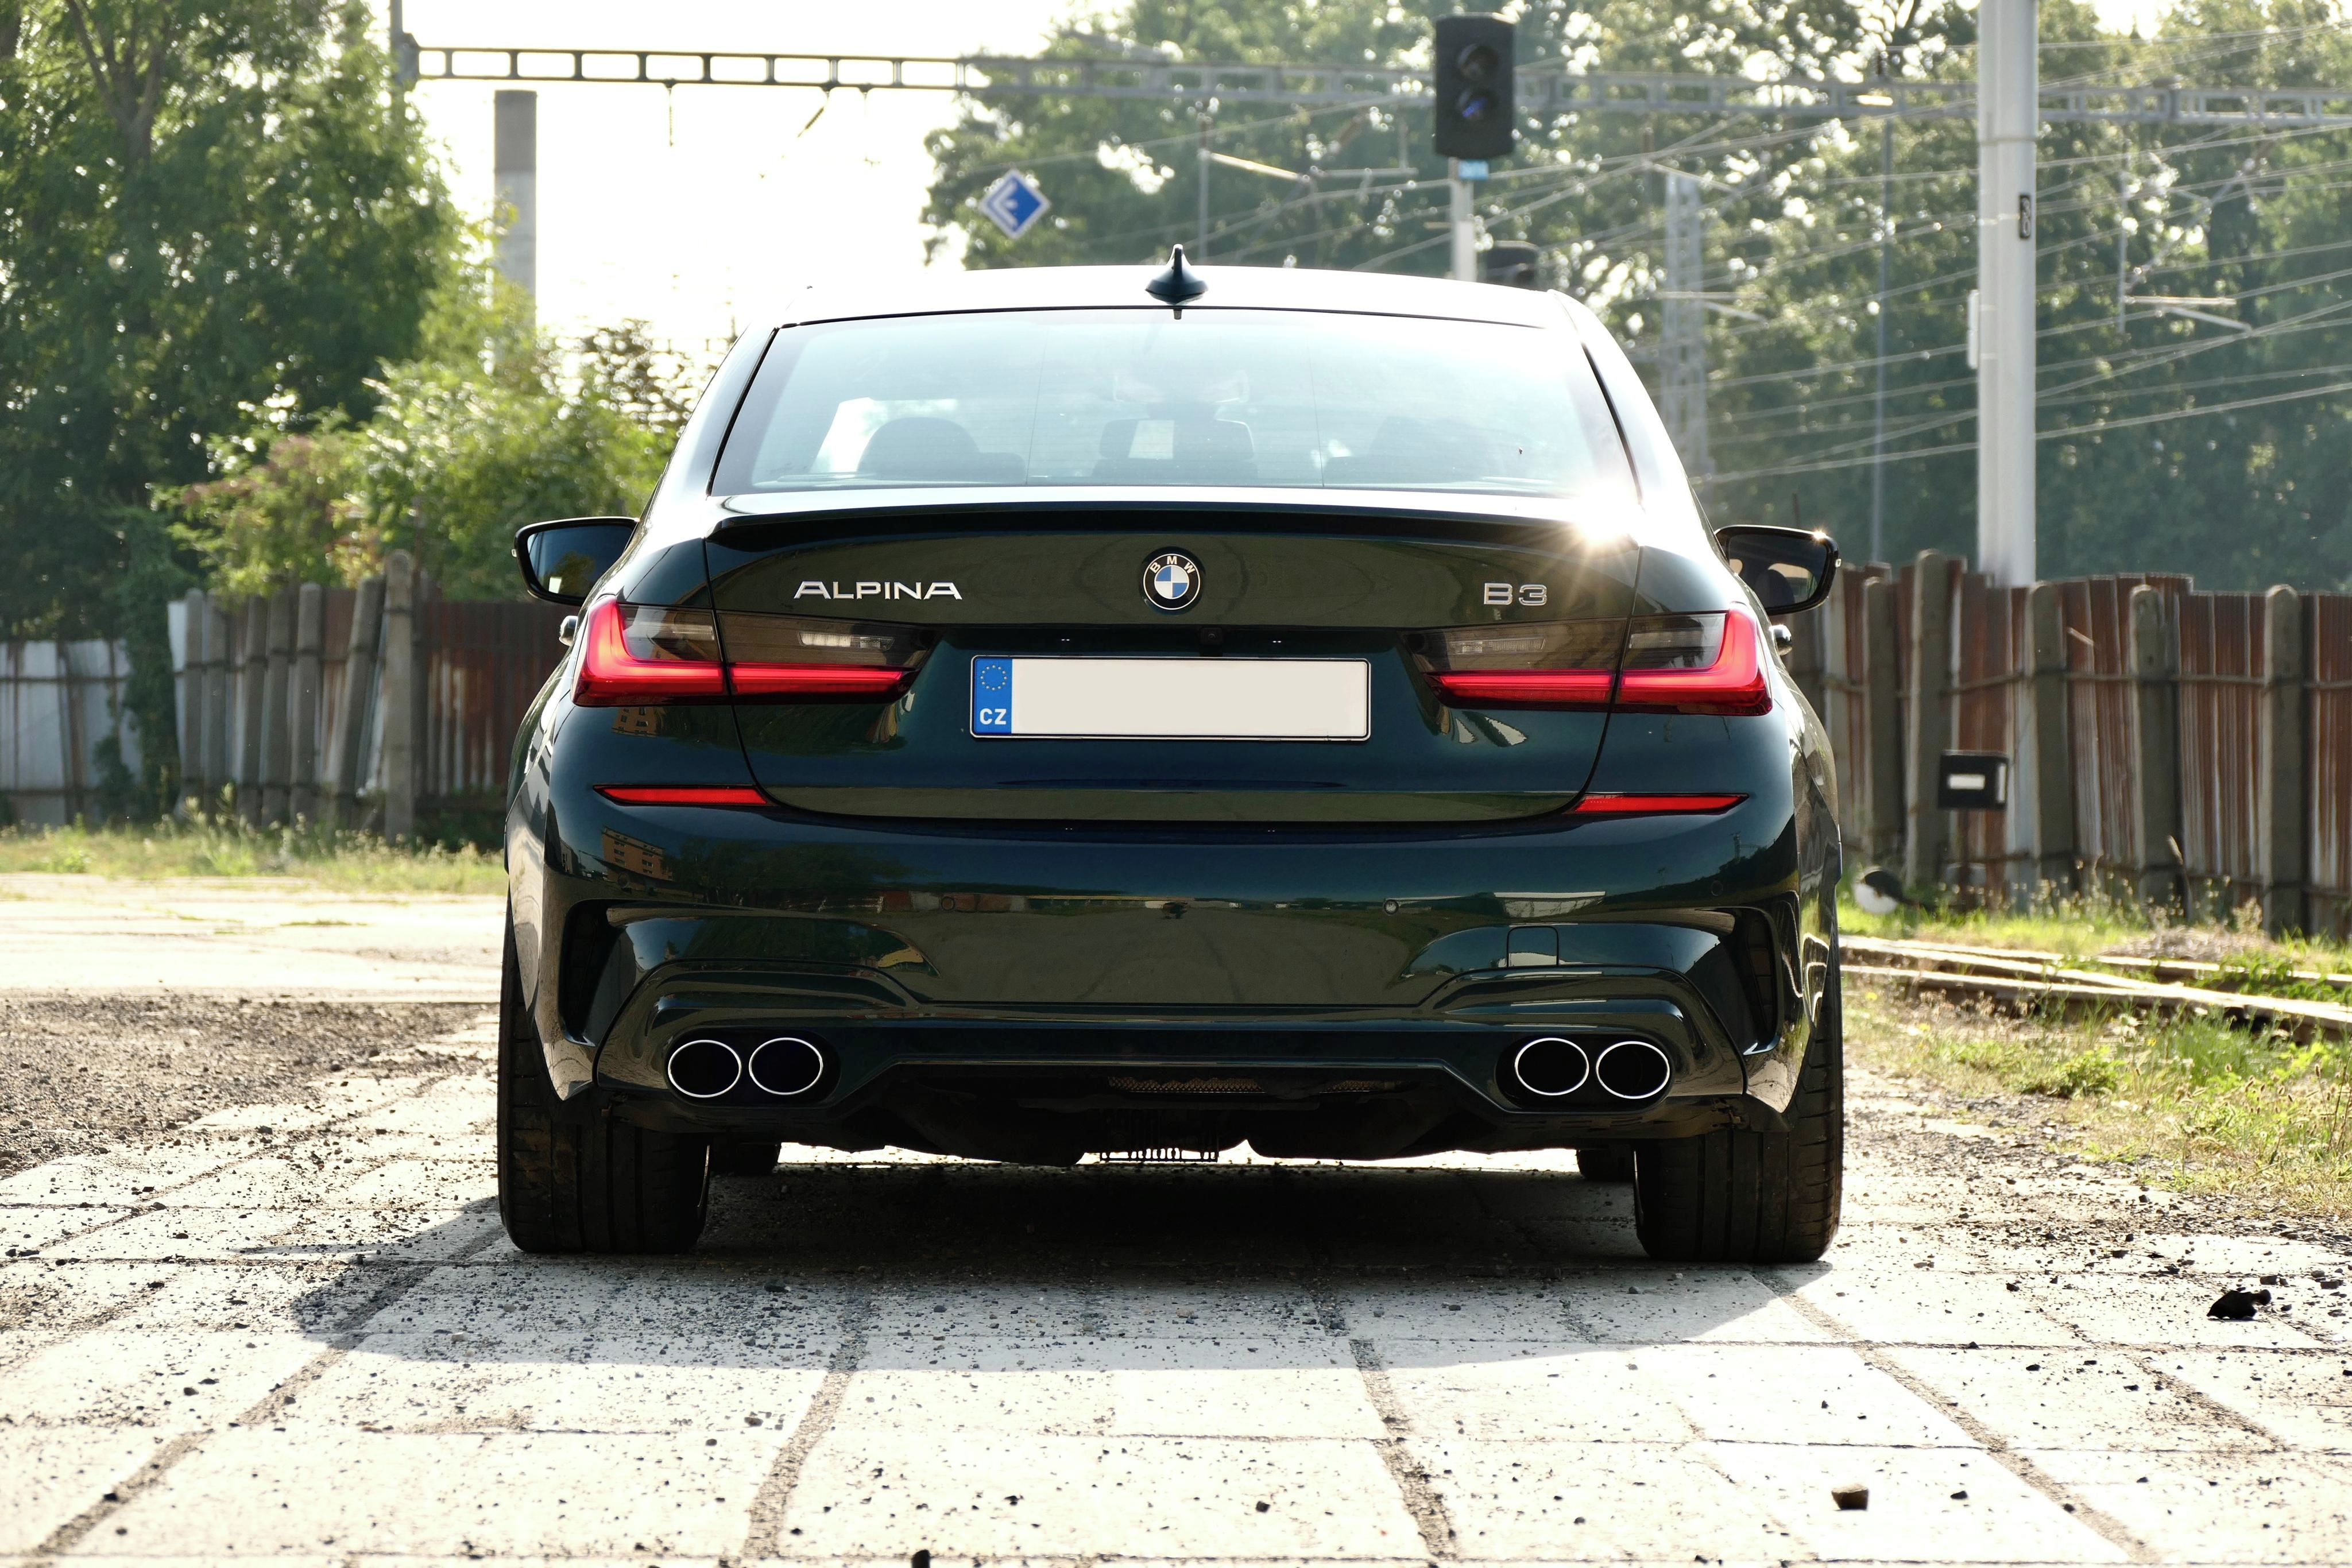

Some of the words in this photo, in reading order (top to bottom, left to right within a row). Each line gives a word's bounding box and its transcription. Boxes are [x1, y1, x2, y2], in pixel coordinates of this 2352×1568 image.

[1150, 556, 1196, 574] BMW
[794, 580, 962, 599] ALPINA
[1484, 583, 1548, 606] B3
[980, 708, 1007, 725] CZ
